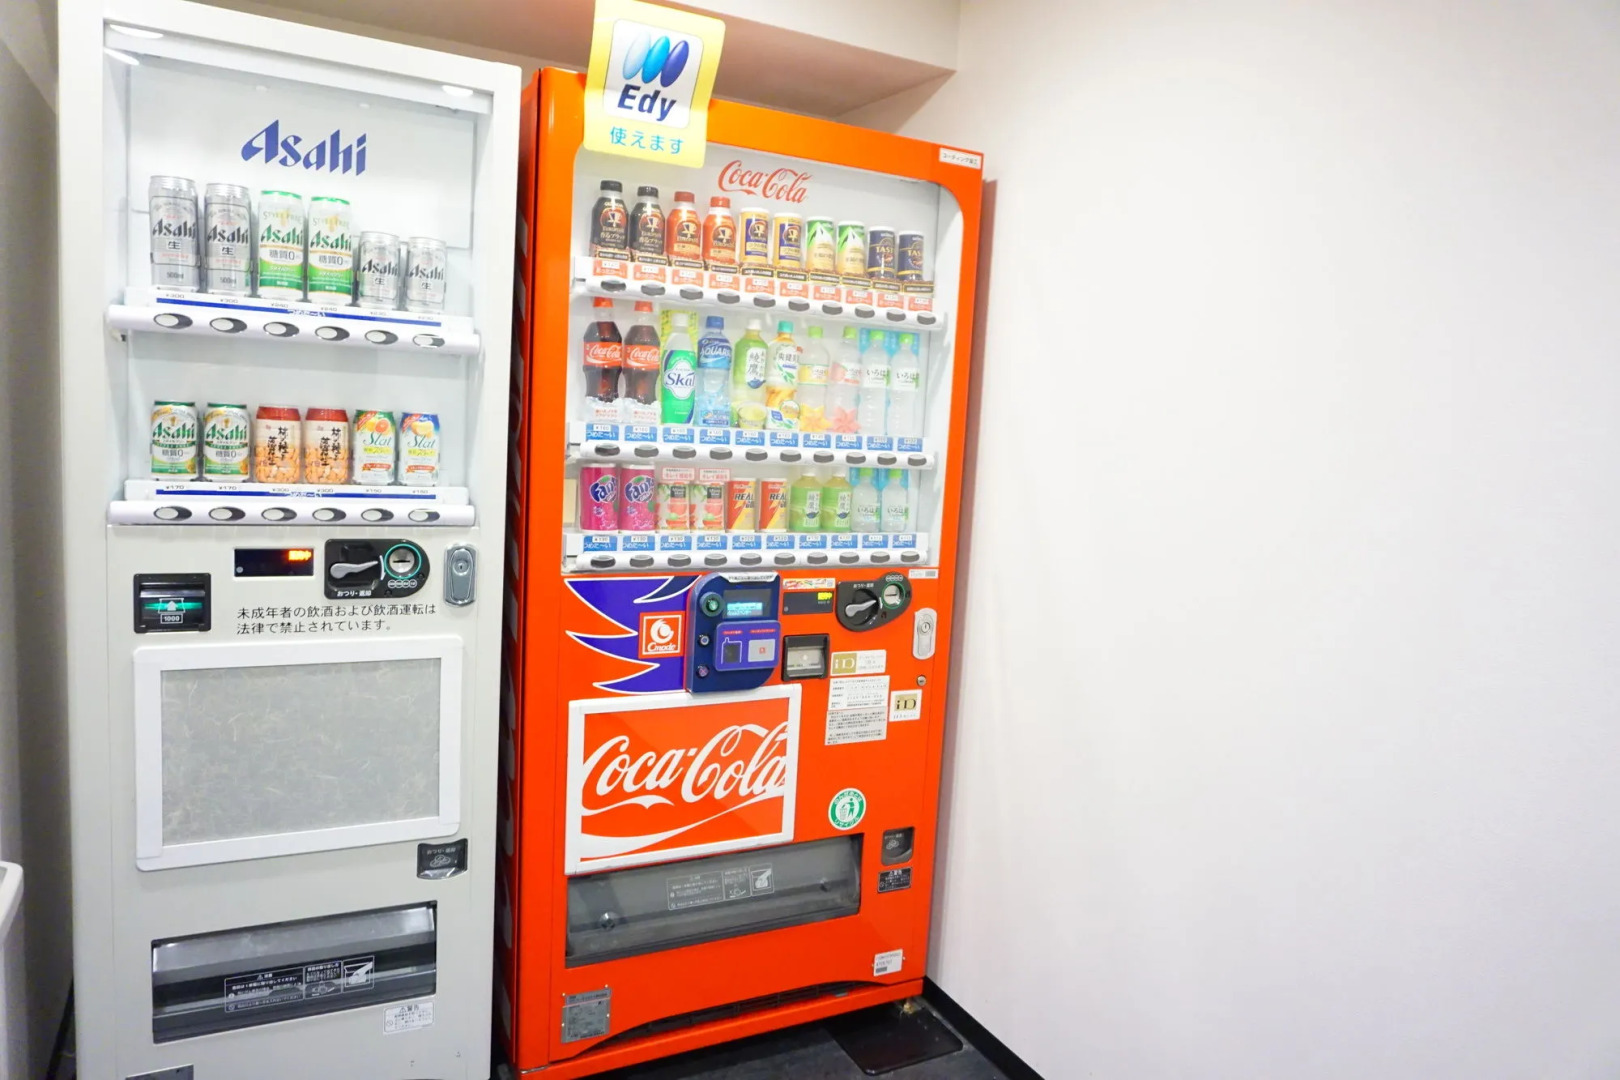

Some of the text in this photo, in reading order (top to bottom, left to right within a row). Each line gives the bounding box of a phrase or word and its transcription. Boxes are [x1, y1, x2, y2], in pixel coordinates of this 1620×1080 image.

[616, 84, 677, 121] Edy
[241, 119, 367, 176] Asahi
[610, 126, 684, 155] 使えます
[717, 159, 812, 205] Coca-Cola
[152, 218, 199, 240] Asahi
[207, 225, 249, 245] Asahi
[260, 224, 303, 247] Asahi
[168, 242, 181, 250] 生
[310, 230, 352, 252] Asahi
[222, 247, 235, 256] 生
[361, 259, 399, 277] Asahi
[409, 264, 444, 281] Asahi
[749, 351, 761, 374] 綾鷹
[152, 421, 195, 440] Asahi
[206, 423, 248, 441] Asahi
[362, 431, 393, 446] Slat
[407, 434, 436, 449] Slat
[161, 449, 184, 457] 糖質0
[216, 450, 237, 459] 糖質0
[237, 603, 435, 624] 未成年者の飲酒および飲酒運転は
[236, 622, 393, 640] 法律で禁止されています。
[647, 641, 677, 652] Cmode
[834, 657, 855, 669] iD
[896, 699, 916, 710] iD
[581, 721, 789, 816] Coca-Cola
